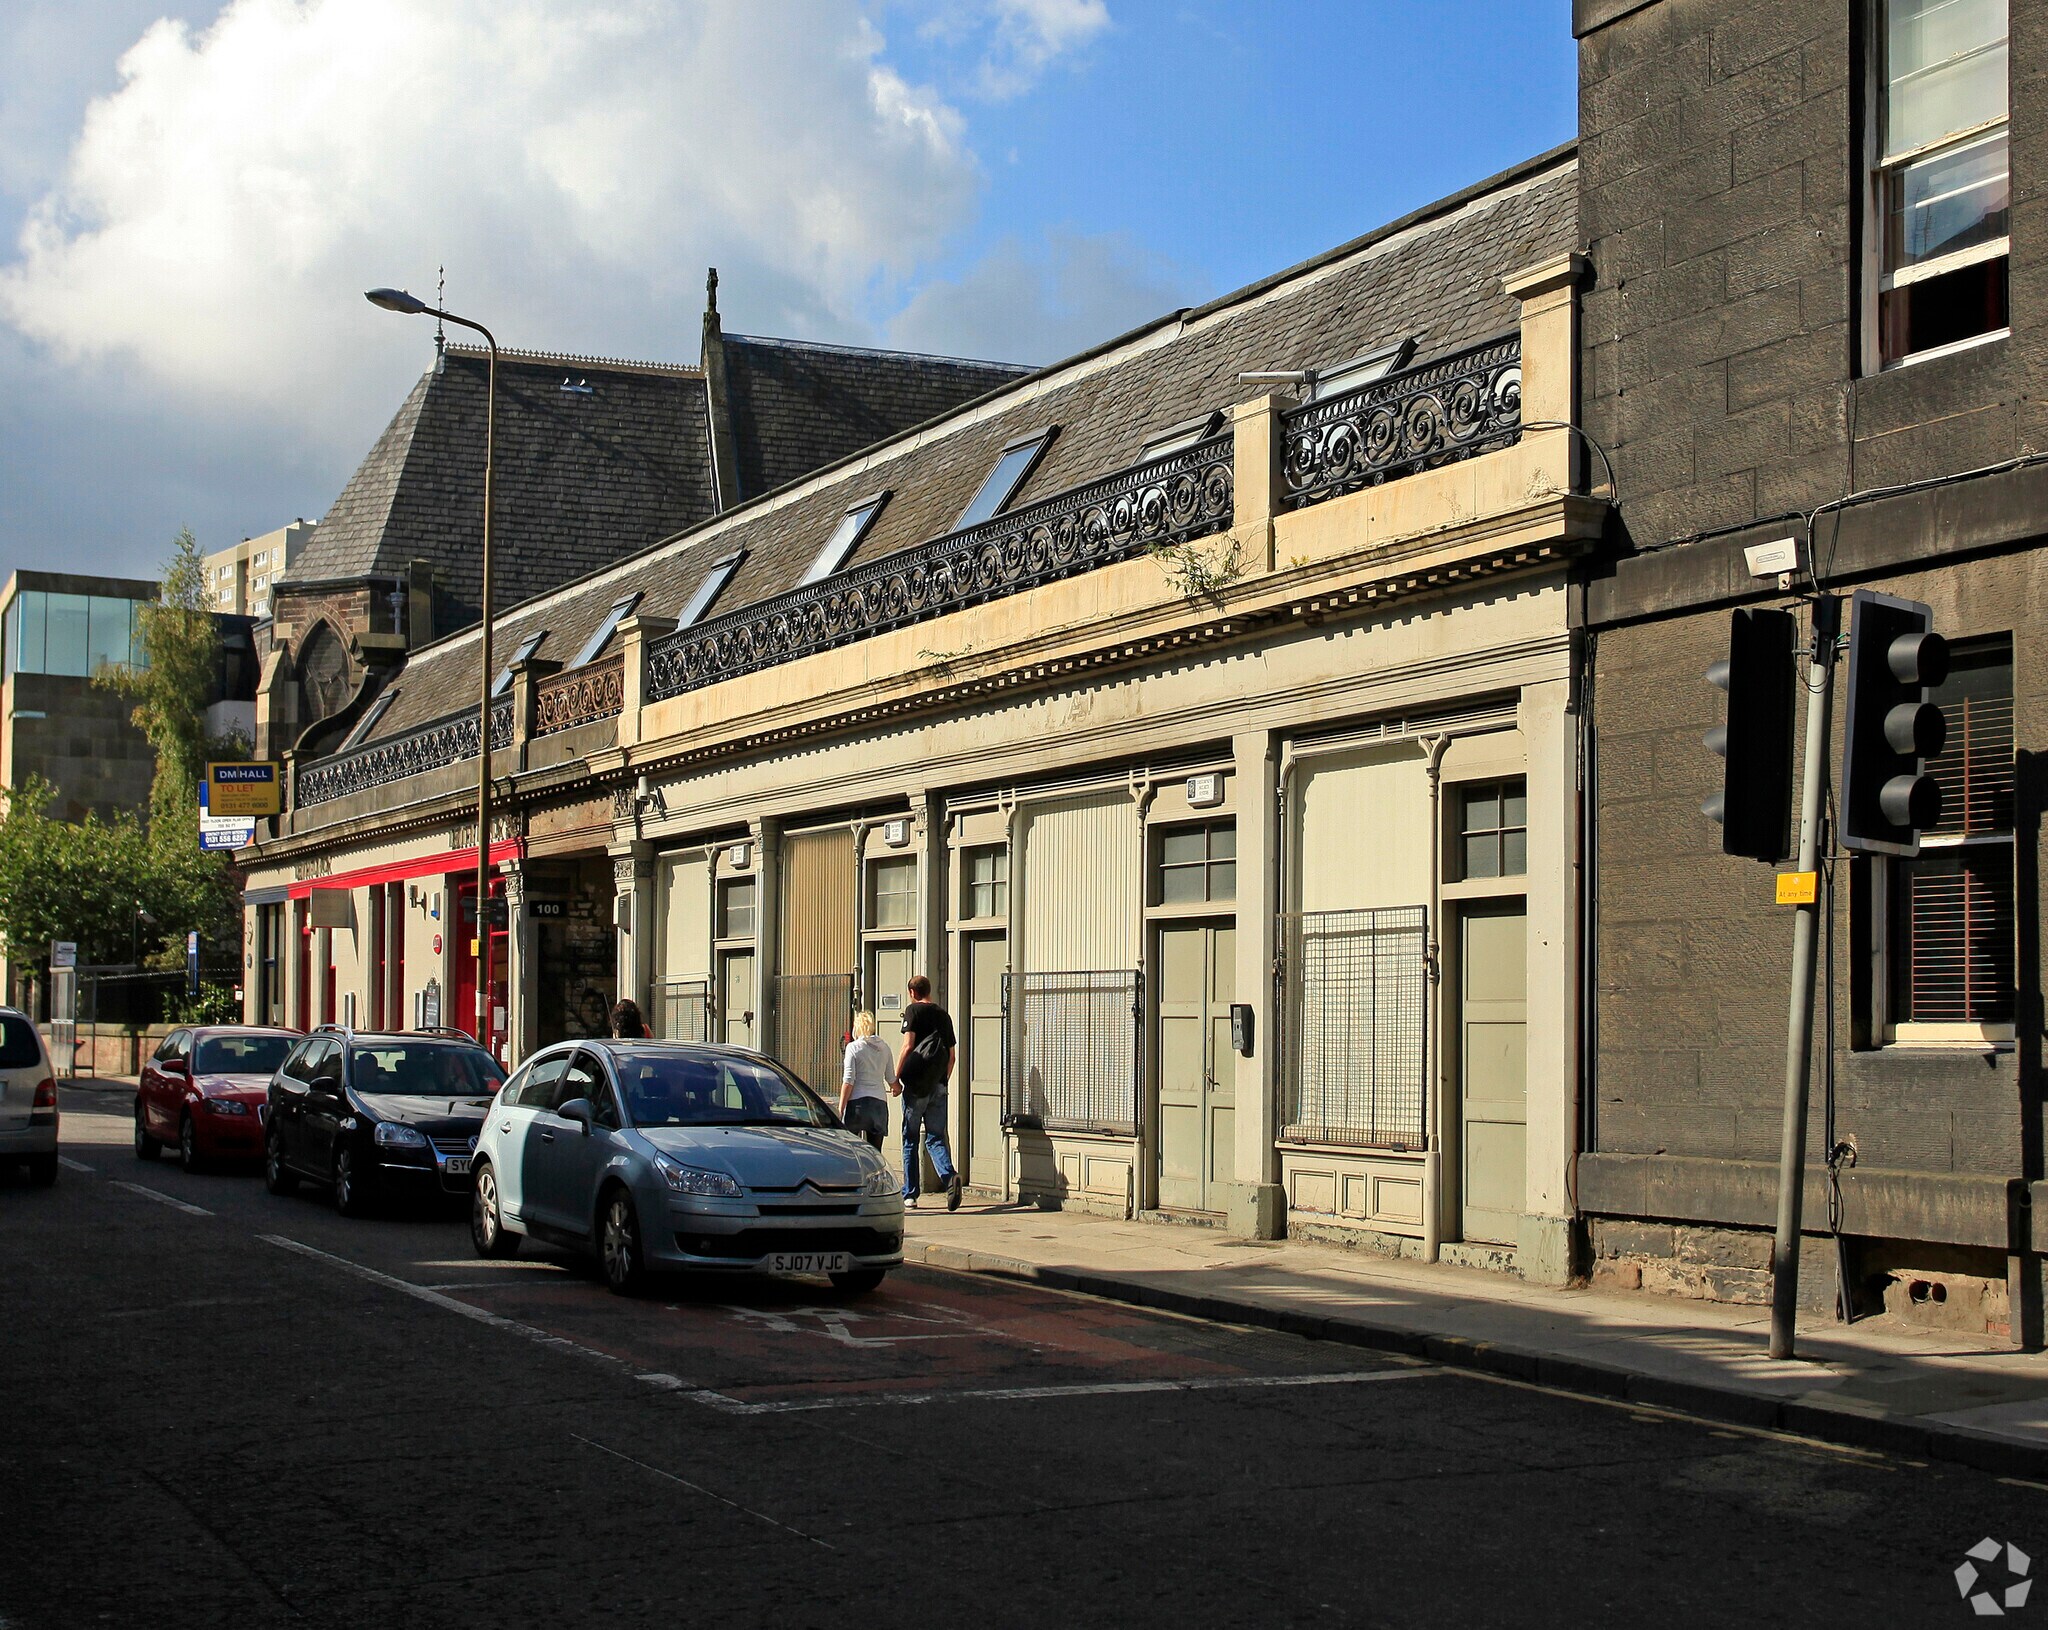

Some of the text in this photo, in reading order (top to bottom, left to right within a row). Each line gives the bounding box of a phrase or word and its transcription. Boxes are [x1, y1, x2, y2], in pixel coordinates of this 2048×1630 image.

[219, 770, 268, 779] DM HALL
[221, 784, 255, 793] TO LET
[537, 904, 560, 914] 100
[775, 1255, 843, 1271] SJ07 VJC
